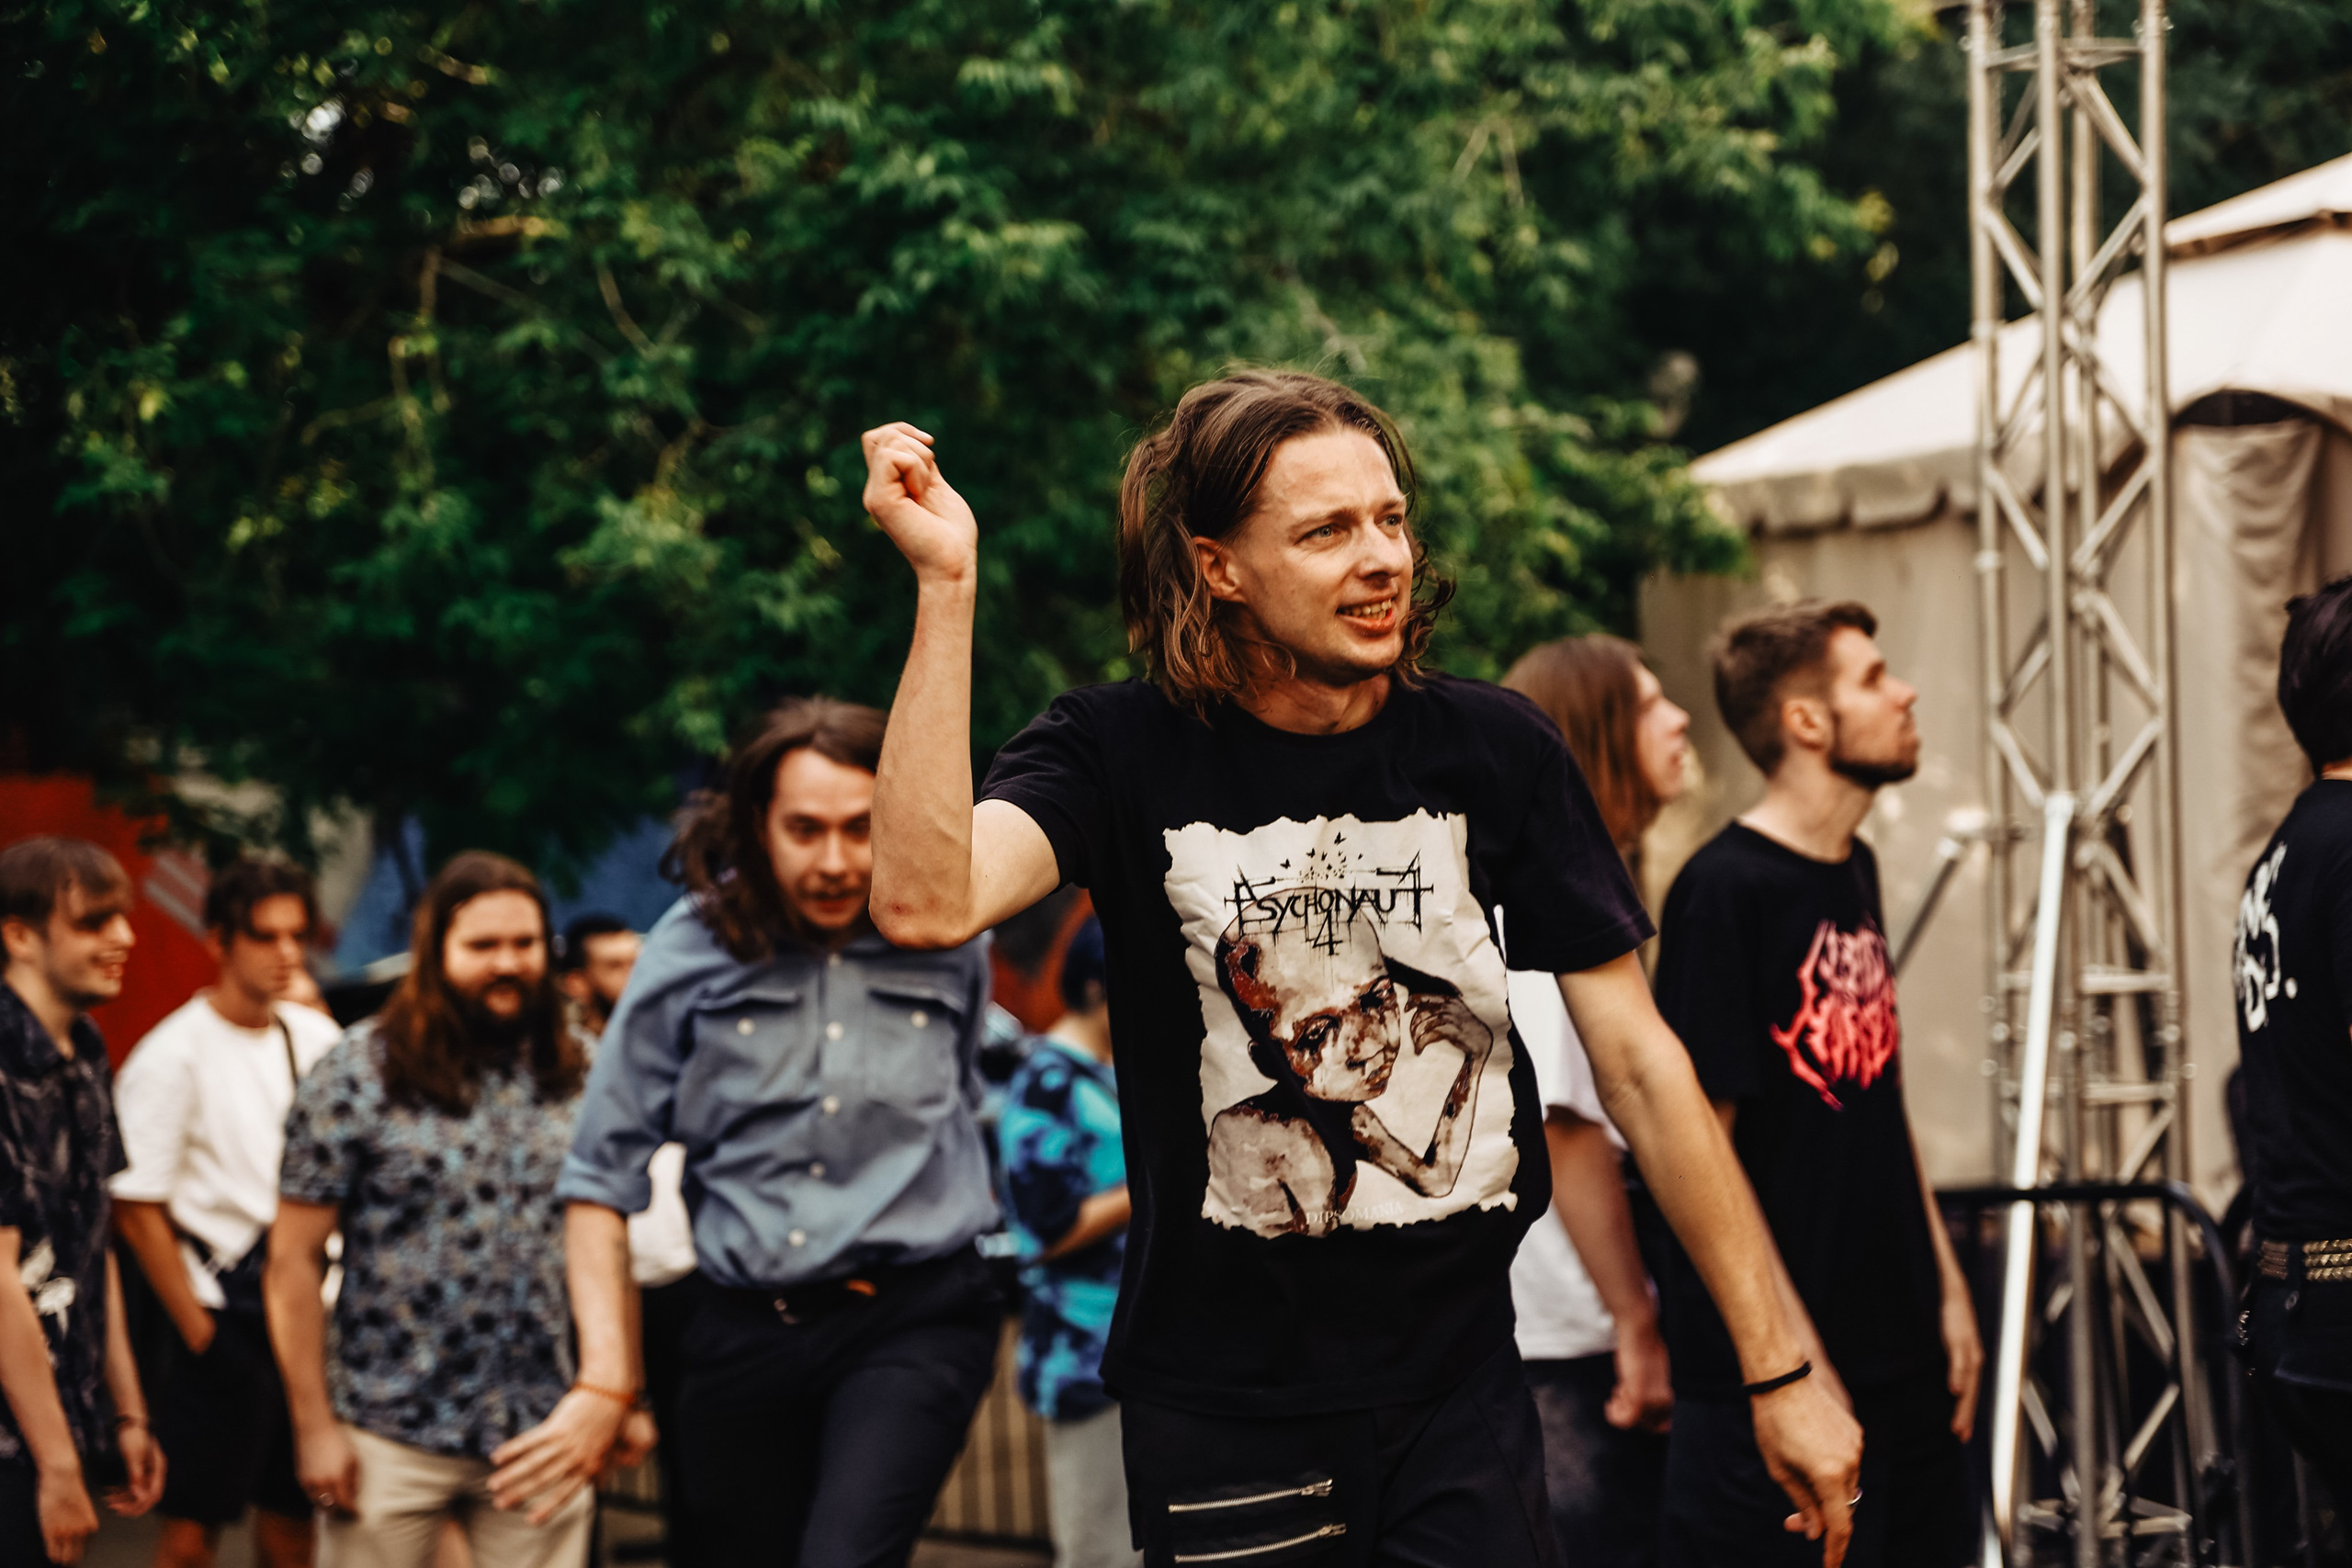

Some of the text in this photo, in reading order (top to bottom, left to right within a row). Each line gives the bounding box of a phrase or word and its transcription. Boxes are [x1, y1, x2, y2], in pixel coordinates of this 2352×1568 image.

[1225, 850, 1434, 935] PSYCHONAUT
[1312, 910, 1343, 956] 4
[1306, 1202, 1404, 1224] DIPSOMANIA
